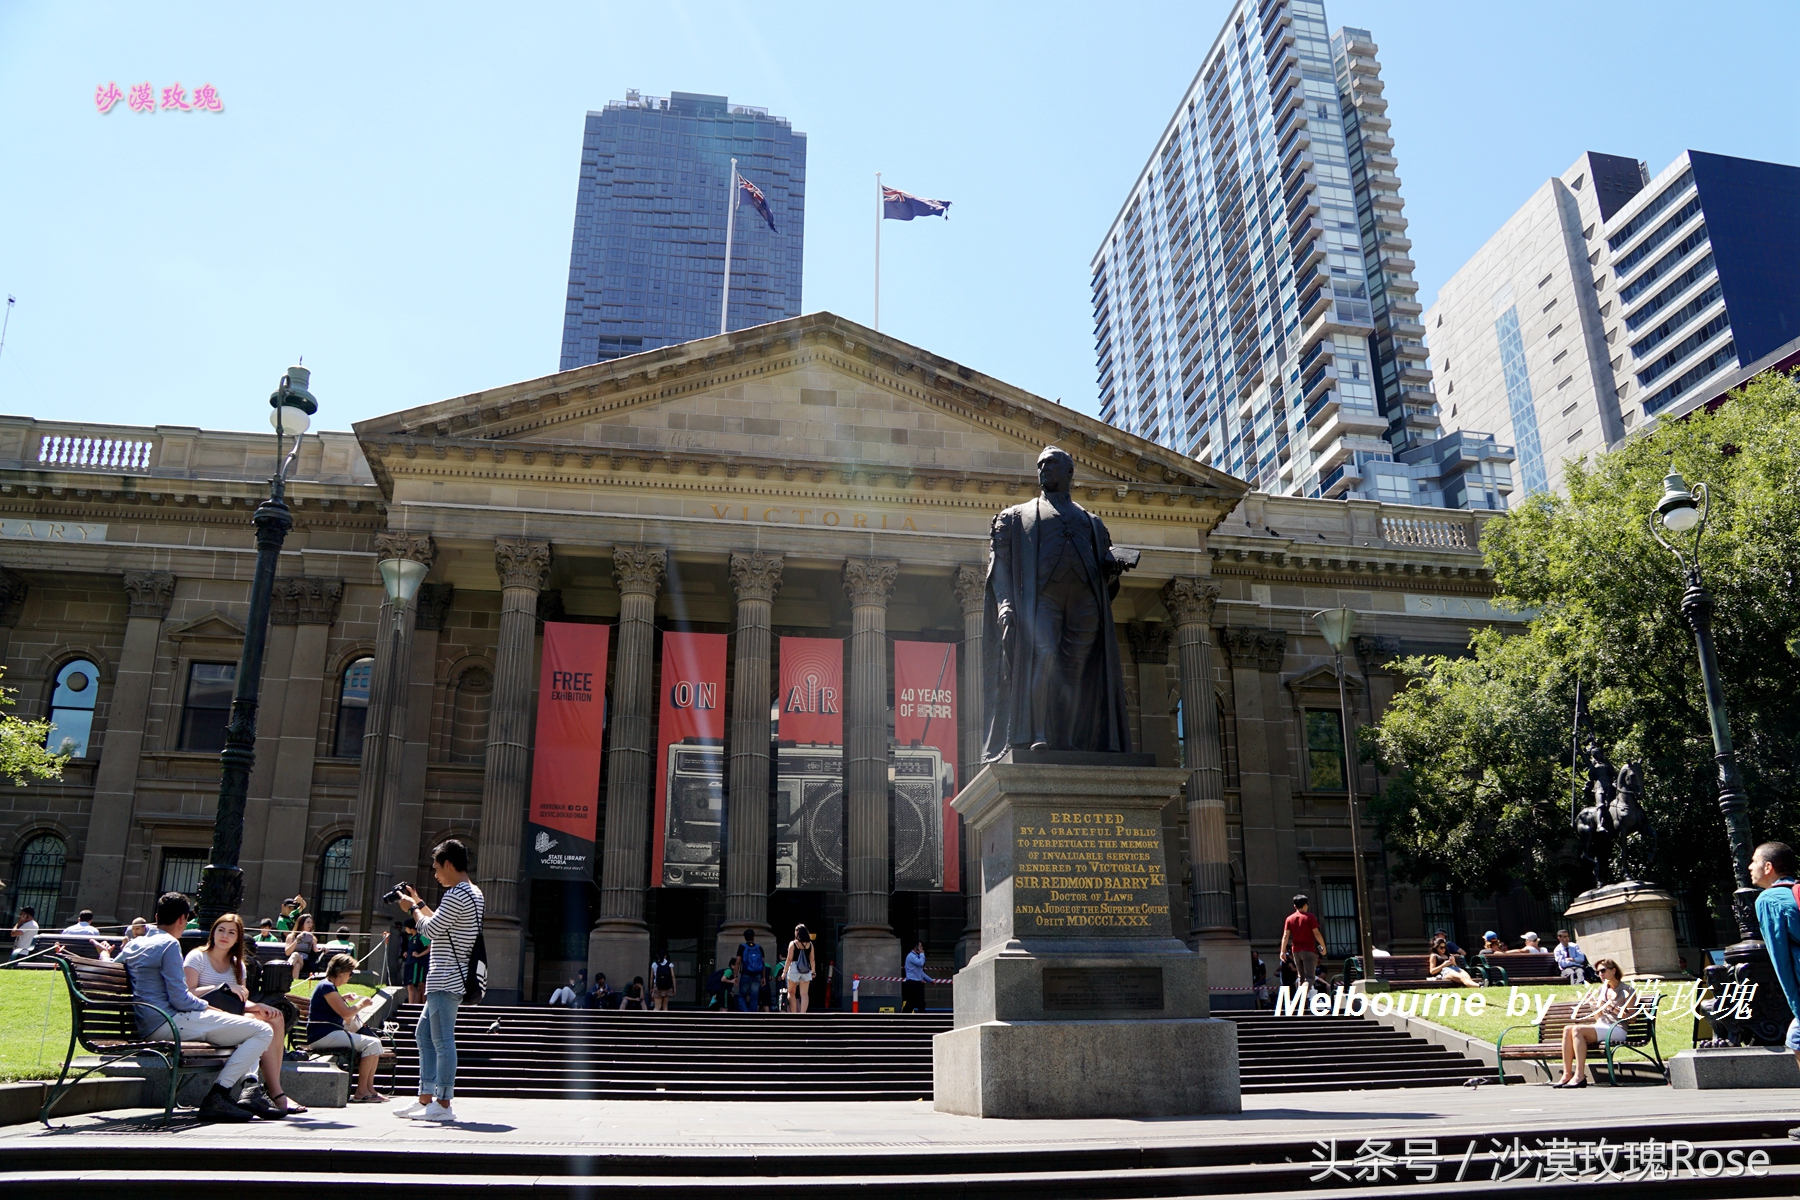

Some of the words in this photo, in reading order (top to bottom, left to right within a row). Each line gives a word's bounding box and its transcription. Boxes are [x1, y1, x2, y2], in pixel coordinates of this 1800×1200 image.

[709, 503, 918, 531] VICTORIA
[552, 671, 593, 692] FREE
[551, 691, 592, 702] EXHIBITION
[671, 680, 717, 710] ON
[785, 674, 839, 714] AIR
[900, 688, 915, 701] 40
[917, 688, 952, 703] YEARS
[900, 703, 915, 717] OF
[1050, 812, 1125, 824] ERECTED
[1020, 826, 1035, 836] BY
[1038, 827, 1047, 836] A
[1050, 827, 1112, 837] GRATEFUL
[1115, 825, 1156, 837] PUBLIC
[1017, 839, 1030, 848] TO
[1032, 839, 1096, 848] PERPETUATE
[1097, 840, 1118, 849] THE
[1120, 840, 1160, 849] MEMORY
[1028, 851, 1040, 860] OF
[1042, 851, 1104, 860] INVALUABLE
[1106, 852, 1151, 861] SERVICES
[1019, 864, 1072, 872] RENDERED
[1075, 864, 1088, 873] TO
[1089, 861, 1146, 873] VICTORIA
[1148, 865, 1161, 873] BY
[1015, 876, 1040, 889] SIR
[1041, 876, 1103, 889] REDMOND
[1103, 877, 1149, 889] BARRY
[1050, 890, 1088, 902] DOCTOR
[1090, 893, 1102, 902] OF
[1104, 890, 1134, 902] LAWS
[1014, 905, 1034, 914] AND
[1034, 905, 1042, 914] A
[1042, 902, 1071, 914] JUDGE
[1071, 905, 1081, 914] OF
[1081, 905, 1099, 914] THE
[1100, 902, 1140, 914] SUPREME
[1141, 903, 1169, 914] COURT
[1035, 915, 1065, 926] OBIIT
